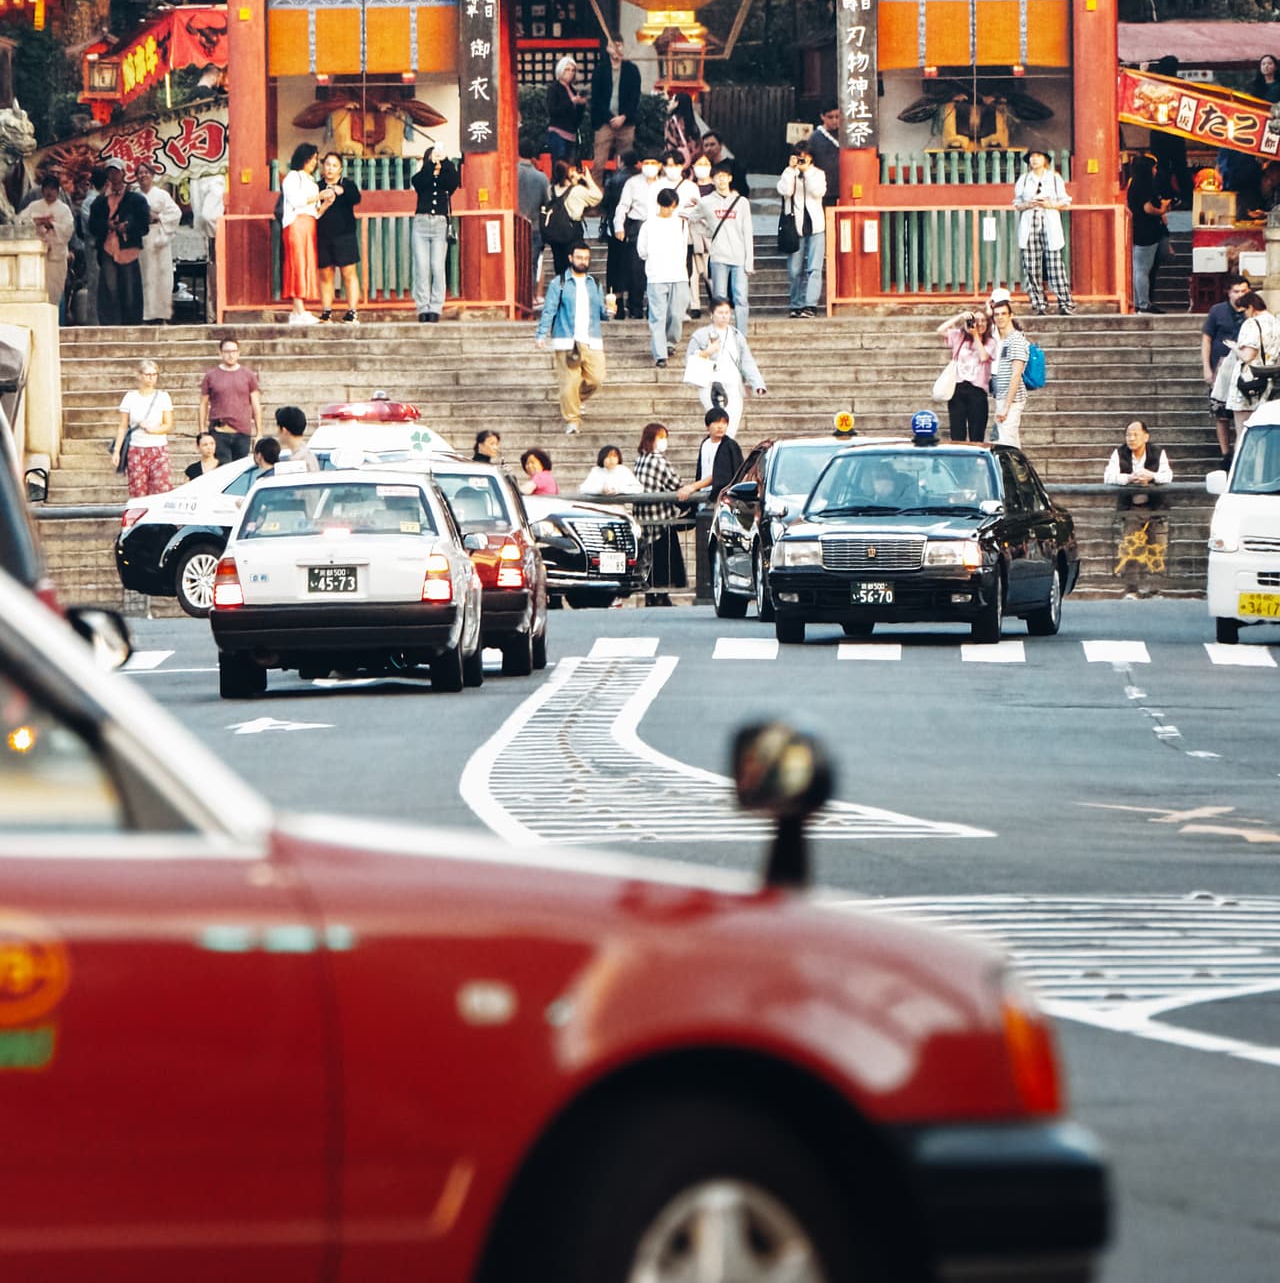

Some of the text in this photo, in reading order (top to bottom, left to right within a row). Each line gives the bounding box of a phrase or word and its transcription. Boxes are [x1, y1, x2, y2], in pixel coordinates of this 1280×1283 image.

[467, 38, 493, 143] 御衣祭
[845, 25, 873, 147] 刃物神社祭
[317, 576, 357, 591] 45-73
[859, 590, 893, 603] 56-70
